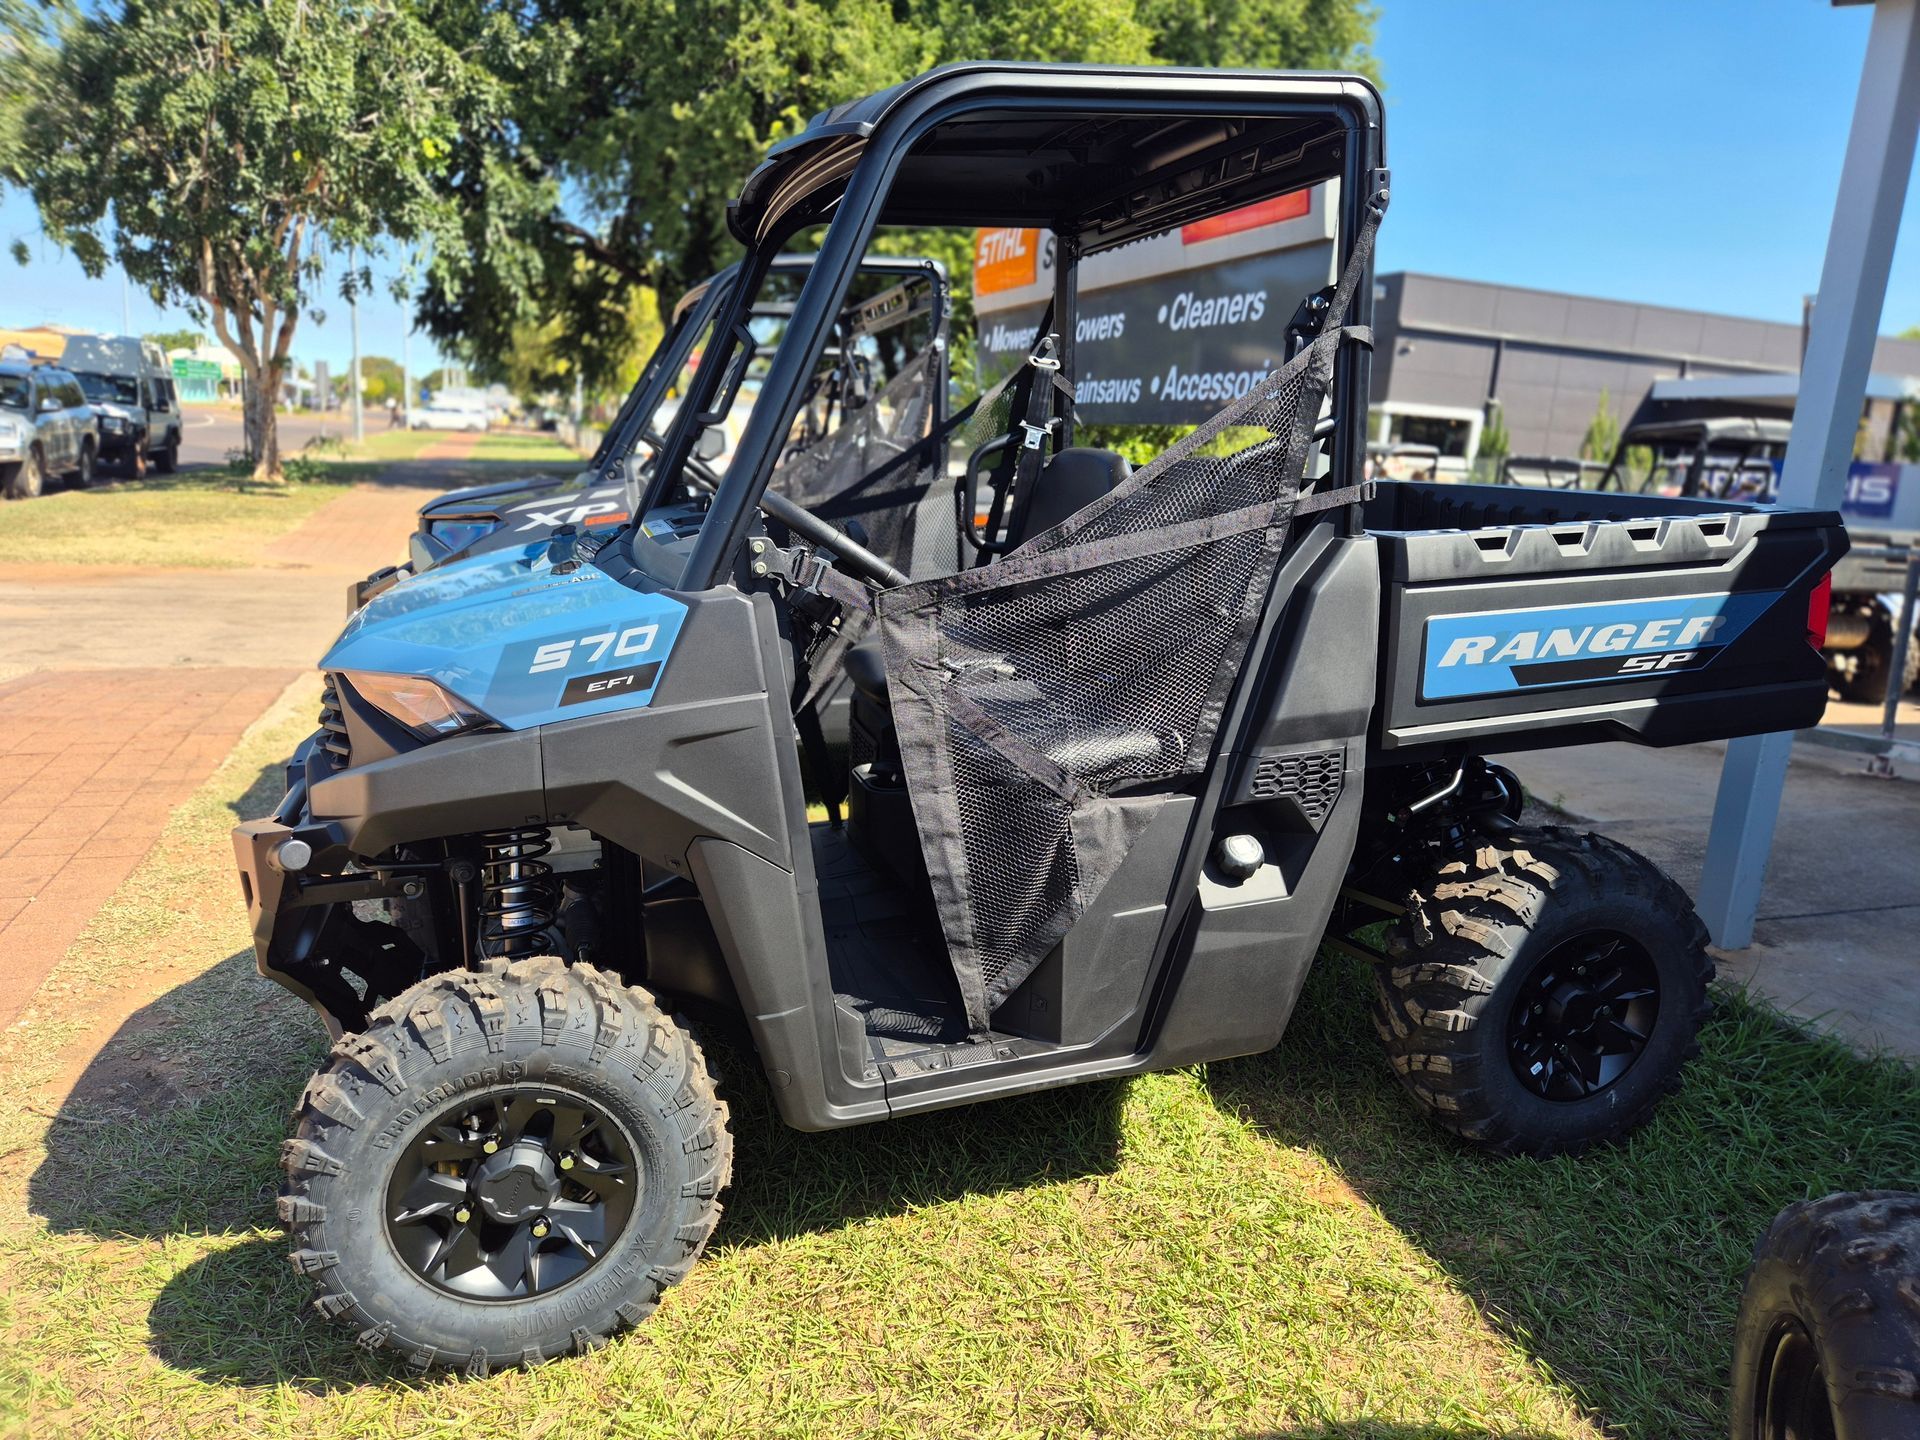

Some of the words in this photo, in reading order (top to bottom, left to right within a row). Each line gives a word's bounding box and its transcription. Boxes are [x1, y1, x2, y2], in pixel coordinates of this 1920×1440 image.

[978, 228, 1026, 268] STIHL
[1170, 290, 1266, 331] Cleaners
[514, 502, 619, 532] XP
[528, 623, 659, 674] 570
[1437, 615, 1726, 668] RANGER
[1617, 651, 1699, 674] SP
[586, 675, 634, 693] EFI
[413, 1067, 499, 1114] ARMOR
